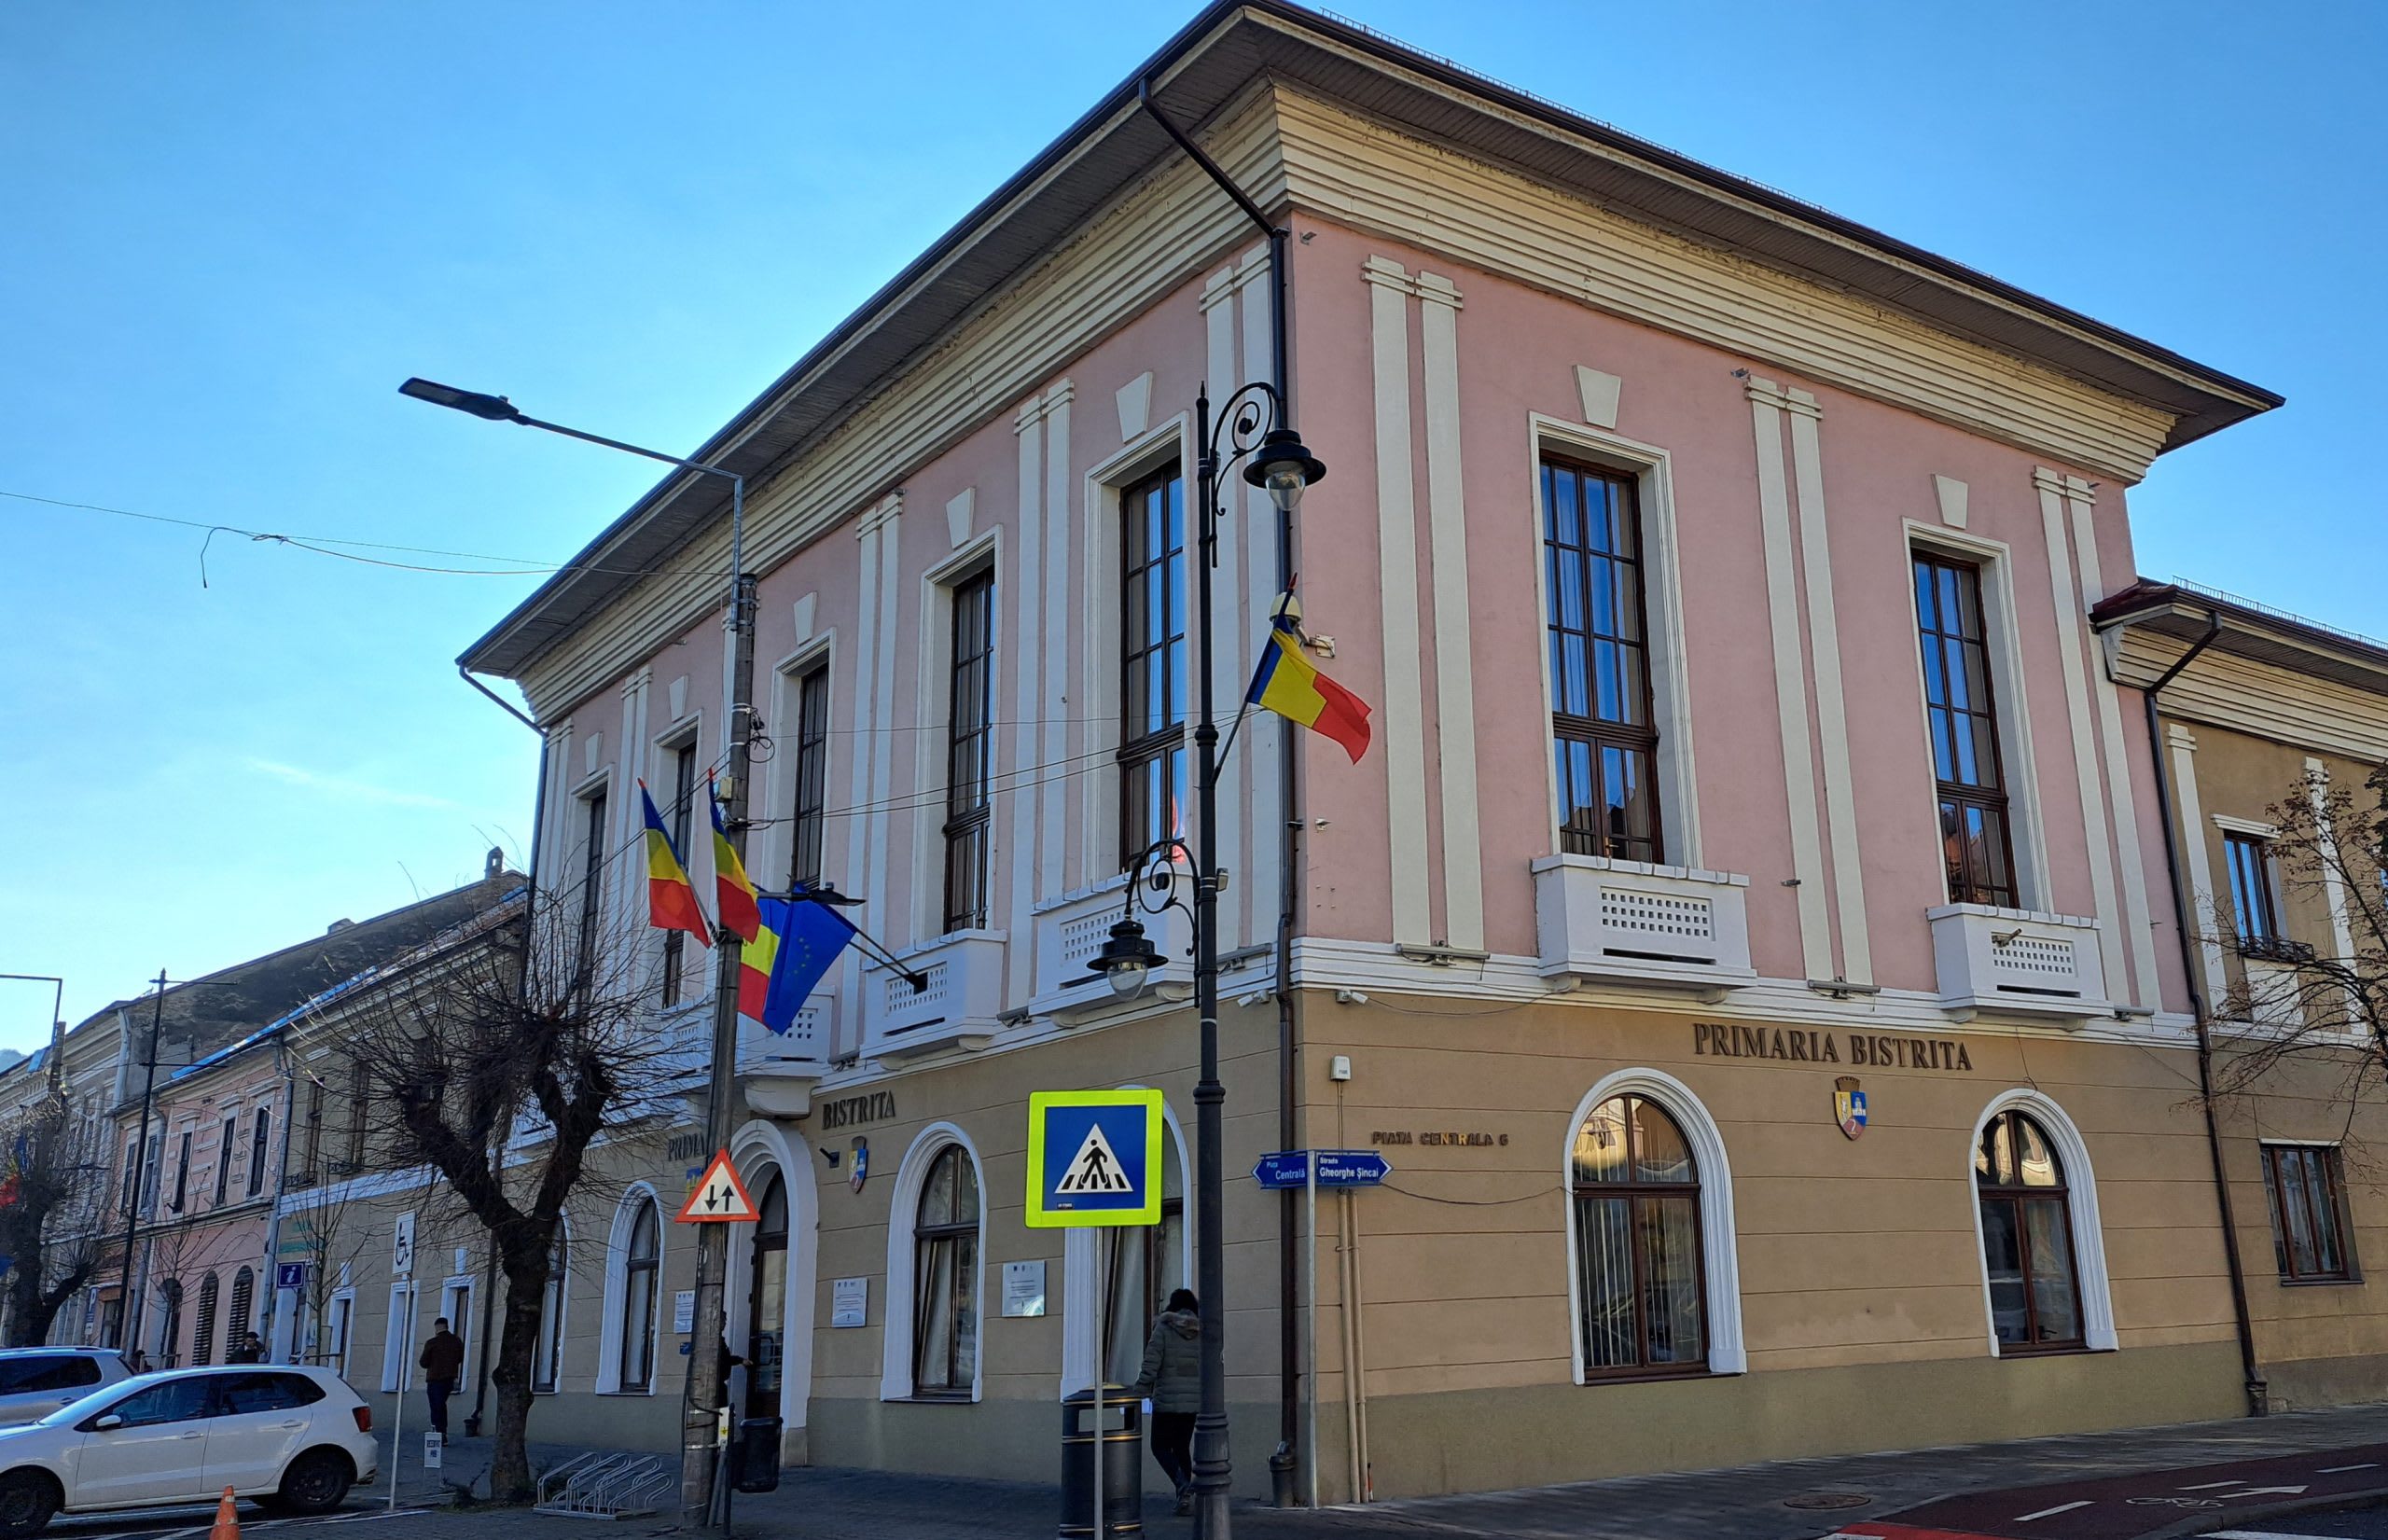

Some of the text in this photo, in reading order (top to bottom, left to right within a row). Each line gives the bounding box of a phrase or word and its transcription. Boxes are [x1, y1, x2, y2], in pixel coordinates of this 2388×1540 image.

[1692, 1022, 1974, 1071] PRIMARIA BISTRITA
[822, 1089, 896, 1131] BISTRITA
[1372, 1131, 1413, 1145] PIATA
[1420, 1131, 1494, 1146] CENTRALA
[1319, 1157, 1339, 1165] Strada
[1275, 1169, 1306, 1181] Centrală
[1319, 1167, 1355, 1179] Gheorghe
